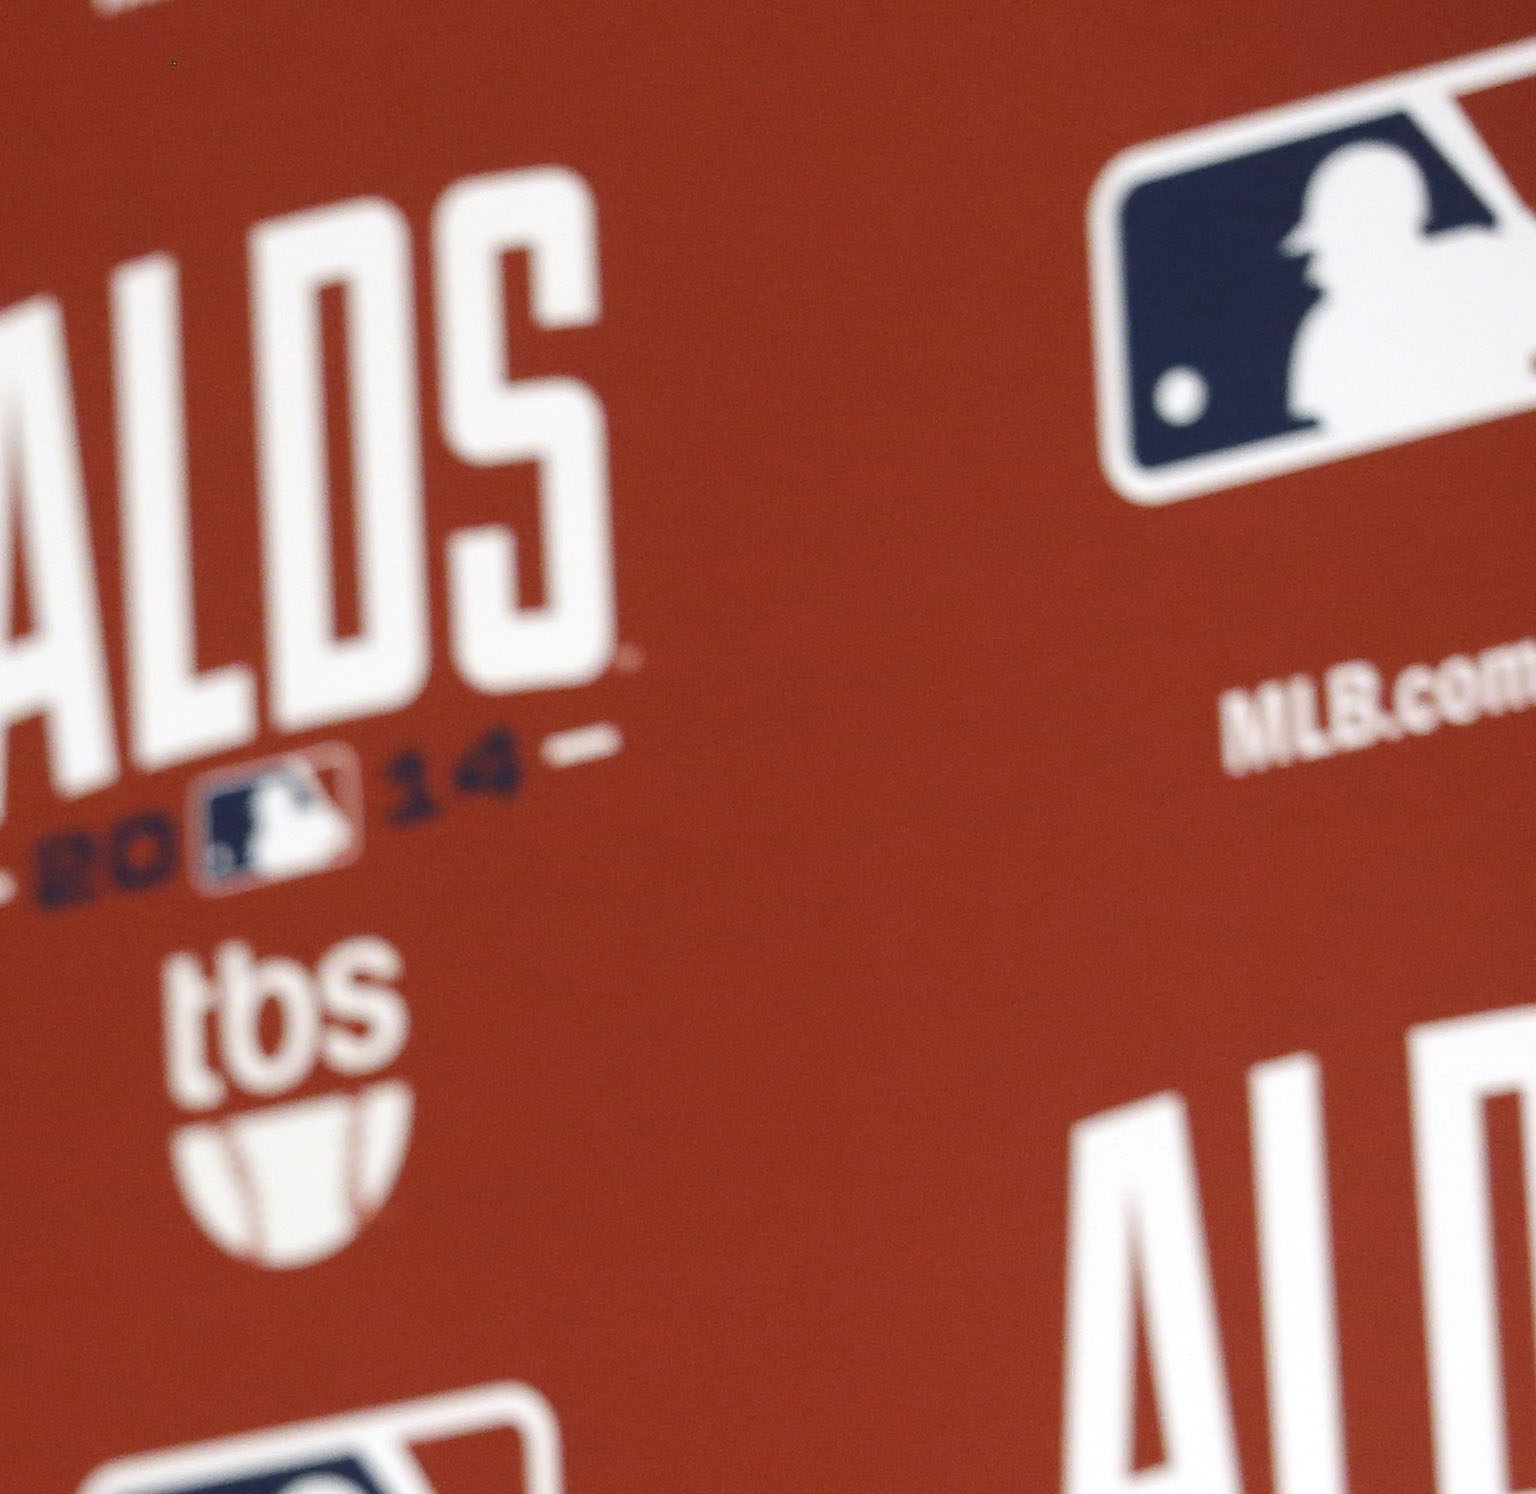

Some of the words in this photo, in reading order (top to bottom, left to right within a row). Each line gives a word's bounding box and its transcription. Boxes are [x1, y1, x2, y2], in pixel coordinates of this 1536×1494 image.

[384, 727, 522, 828] 14
[1218, 636, 1536, 778] MLB.com
[159, 934, 411, 1112] tbs
